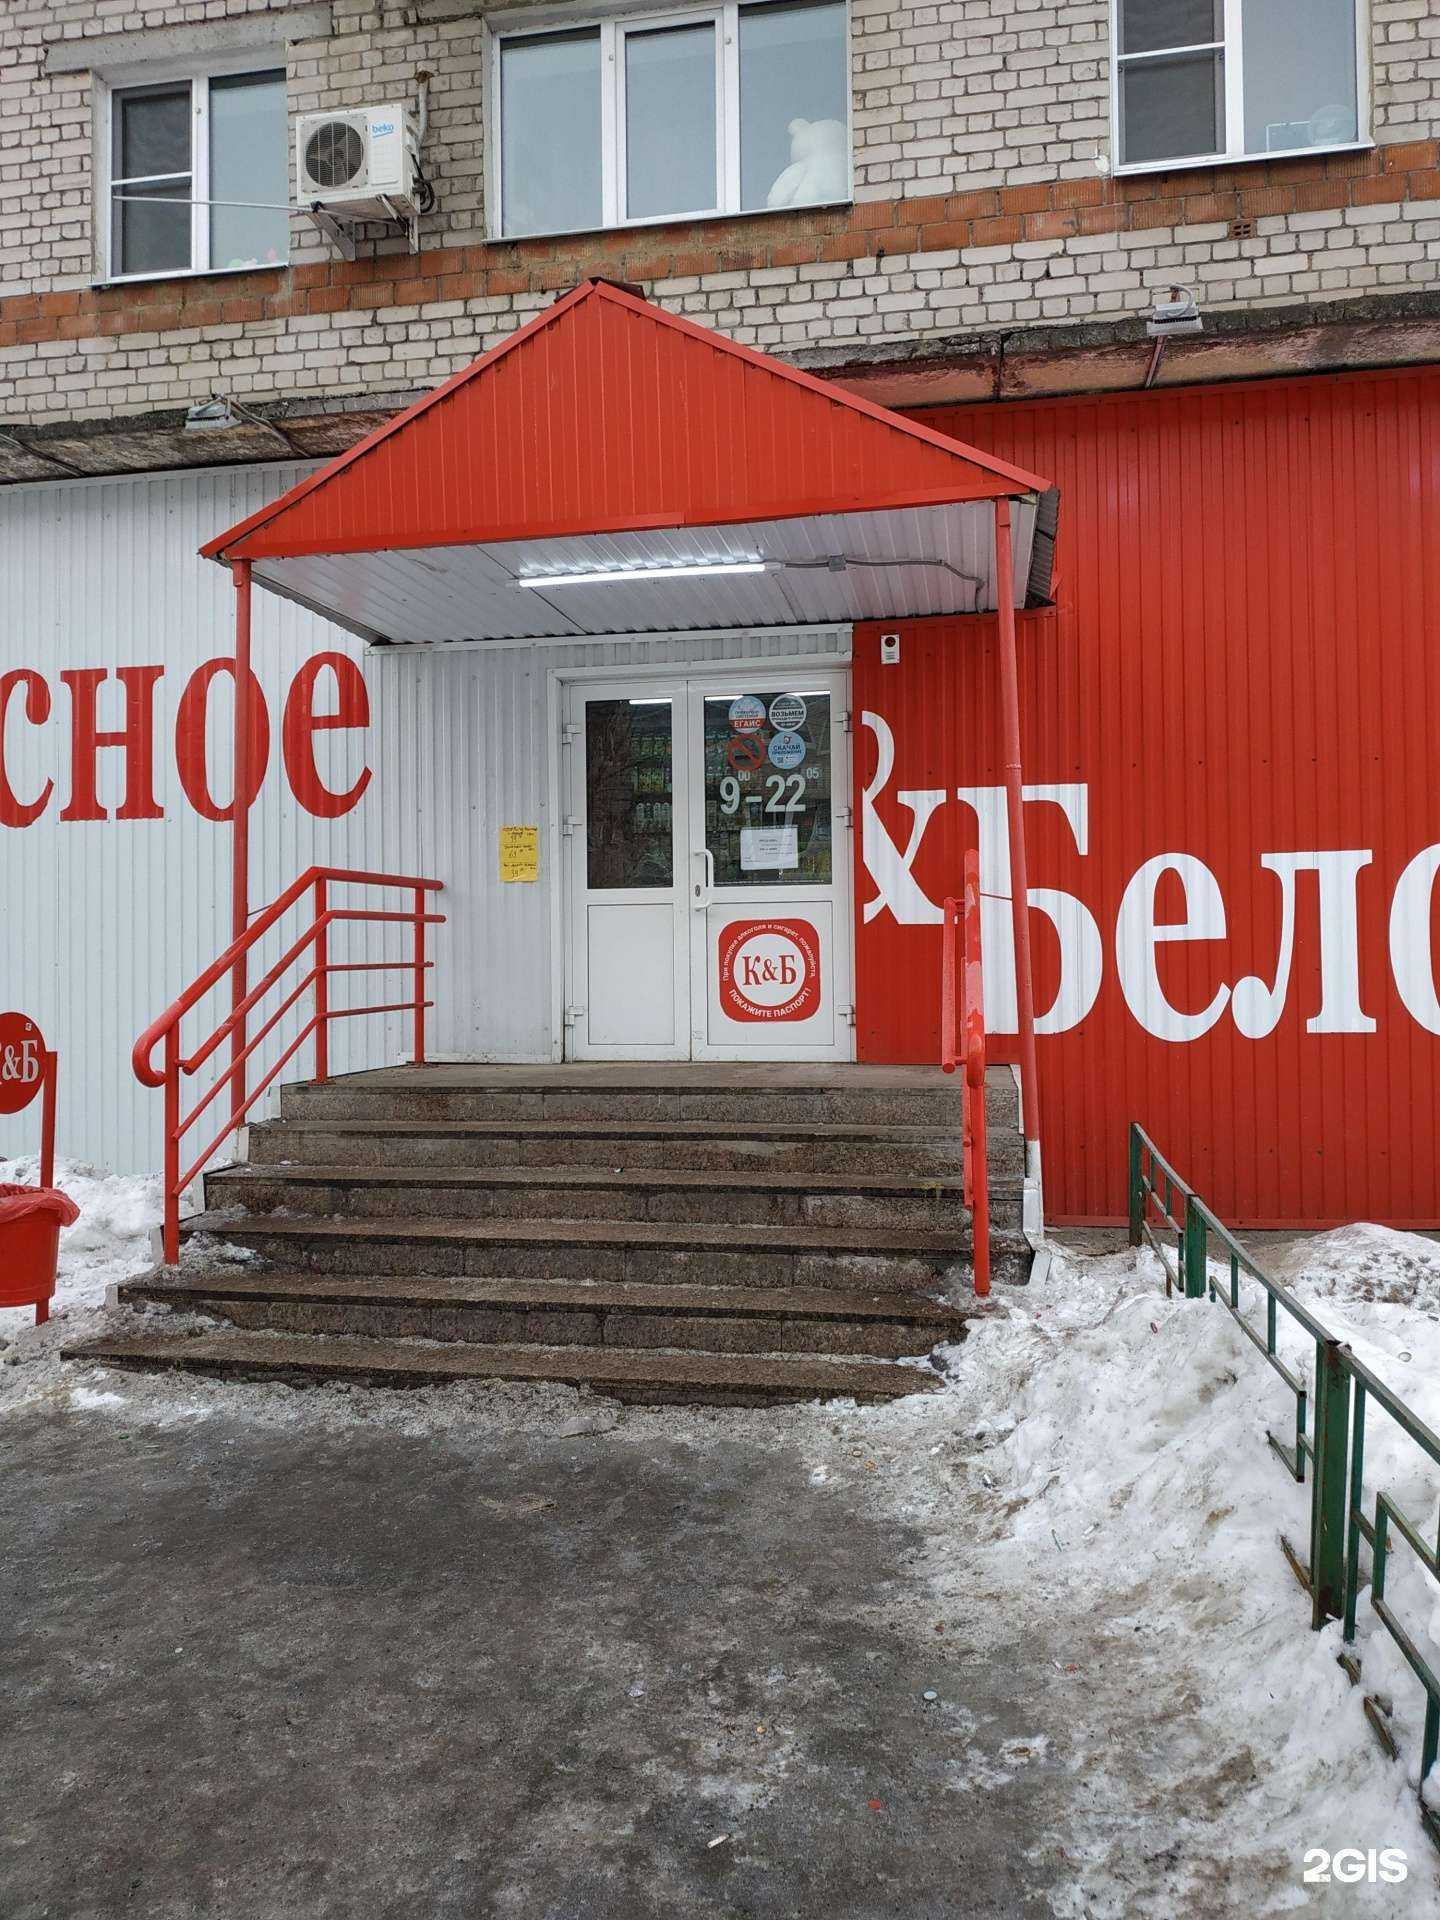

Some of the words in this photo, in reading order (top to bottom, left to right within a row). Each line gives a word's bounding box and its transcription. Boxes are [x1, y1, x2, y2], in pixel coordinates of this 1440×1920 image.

[371, 123, 394, 134] beko
[734, 720, 761, 728] ЕГАИС
[765, 774, 806, 812] 22
[737, 924, 767, 940] алкоголя
[741, 954, 797, 986] К&Б
[728, 988, 773, 1018] ПОКАЖИТЕ
[773, 987, 812, 1018] ПАСПОРТ!
[0, 1039, 39, 1086] &Б
